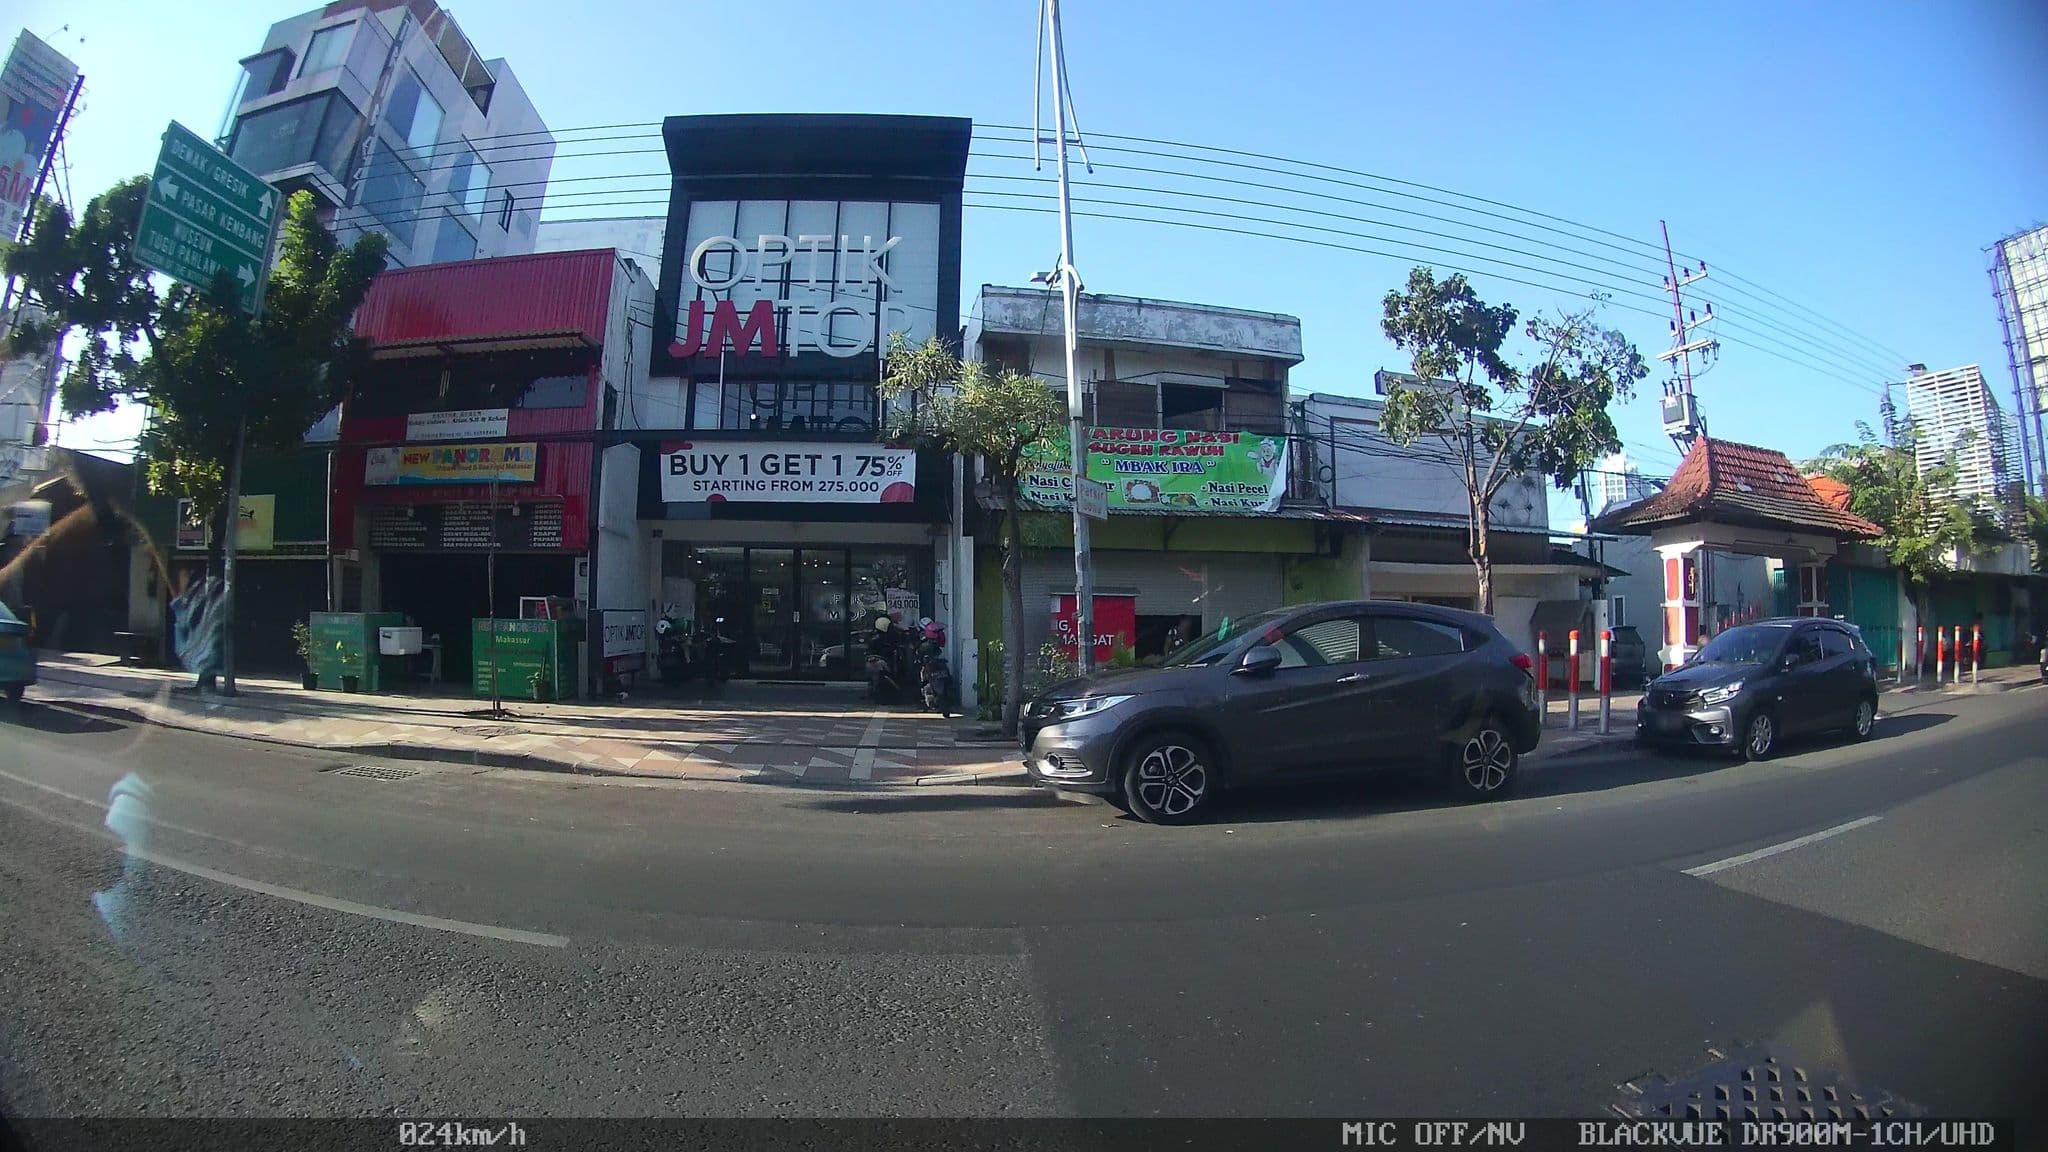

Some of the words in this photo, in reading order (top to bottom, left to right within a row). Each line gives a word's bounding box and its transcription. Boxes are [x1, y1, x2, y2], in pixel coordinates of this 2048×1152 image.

[182, 189, 216, 221] PASAR
[690, 235, 902, 293] OPTIK
[1083, 427, 1178, 443] ARUNG
[403, 452, 430, 465] NEW
[669, 454, 729, 476] BUY
[739, 454, 749, 475] 1
[760, 454, 822, 476] GET
[832, 455, 842, 476] 1
[1115, 459, 1168, 473] MBAK
[1172, 461, 1205, 474] IRA
[693, 480, 766, 491] STARTING
[771, 480, 813, 492] FROM
[818, 481, 879, 493] 275.000
[1029, 475, 1058, 488] Nasi
[1208, 482, 1235, 494] Nasi
[1238, 483, 1268, 494] Pecel
[1030, 491, 1059, 501] Nasi
[1211, 497, 1238, 507] Nasi
